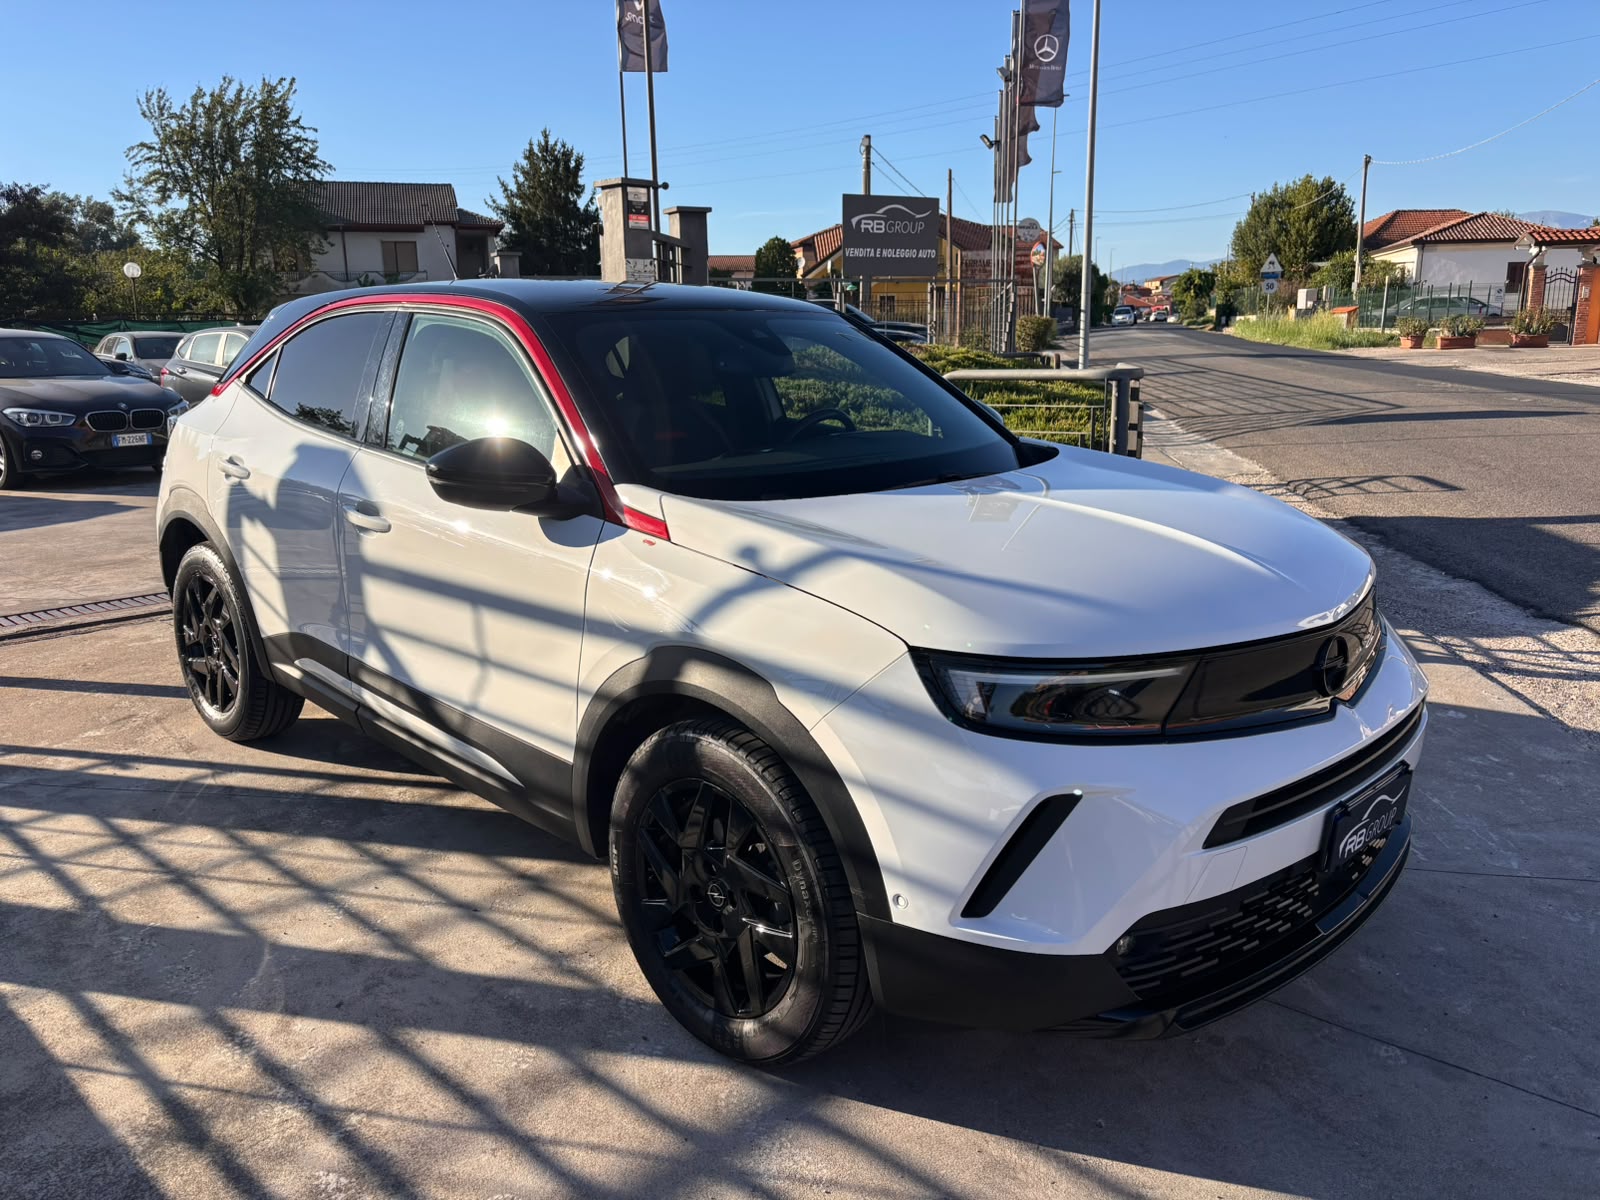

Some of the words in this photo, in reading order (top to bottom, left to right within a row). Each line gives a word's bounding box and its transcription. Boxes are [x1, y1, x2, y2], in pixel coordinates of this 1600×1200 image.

[625, 11, 655, 25] smat
[845, 248, 874, 257] VENDITA
[876, 249, 881, 257] E
[883, 249, 917, 258] NOLEGGIO
[918, 250, 936, 259] AUTO
